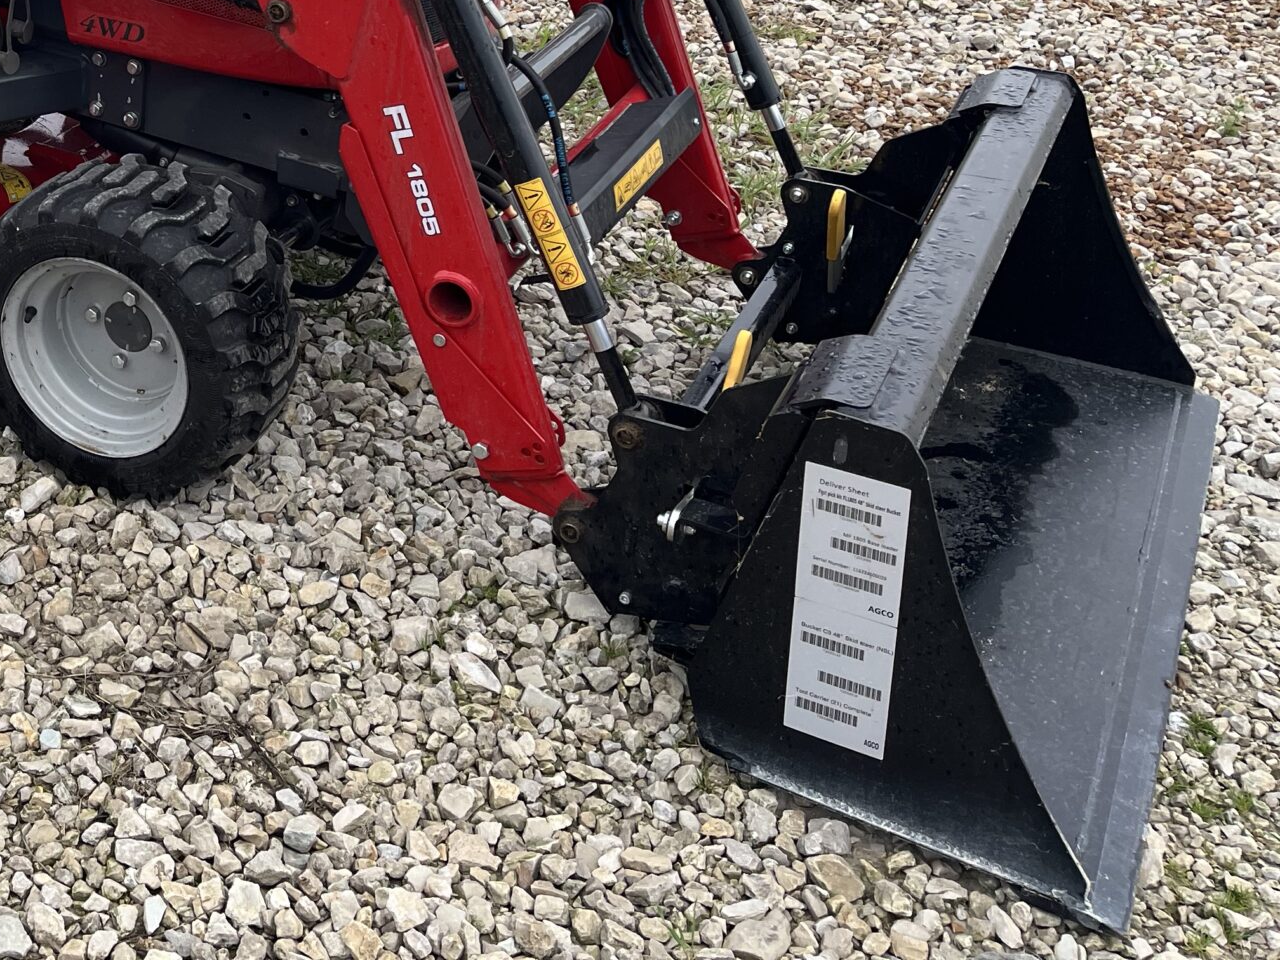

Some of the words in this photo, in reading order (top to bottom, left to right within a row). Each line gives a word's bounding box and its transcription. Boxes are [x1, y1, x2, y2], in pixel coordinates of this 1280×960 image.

[80, 14, 145, 43] 4WD
[382, 104, 414, 155] FL
[406, 163, 441, 236] 1805
[820, 478, 846, 491] Deliver
[848, 486, 870, 498] Sheet
[886, 507, 902, 516] Bucket
[868, 606, 894, 618] AGCO
[801, 621, 822, 632] Bucket
[845, 636, 858, 644] Skid
[860, 641, 874, 649] steer
[796, 686, 808, 695] Tool
[809, 692, 830, 702] Carrier
[843, 703, 872, 718] Complete
[864, 739, 880, 750] AGCO
